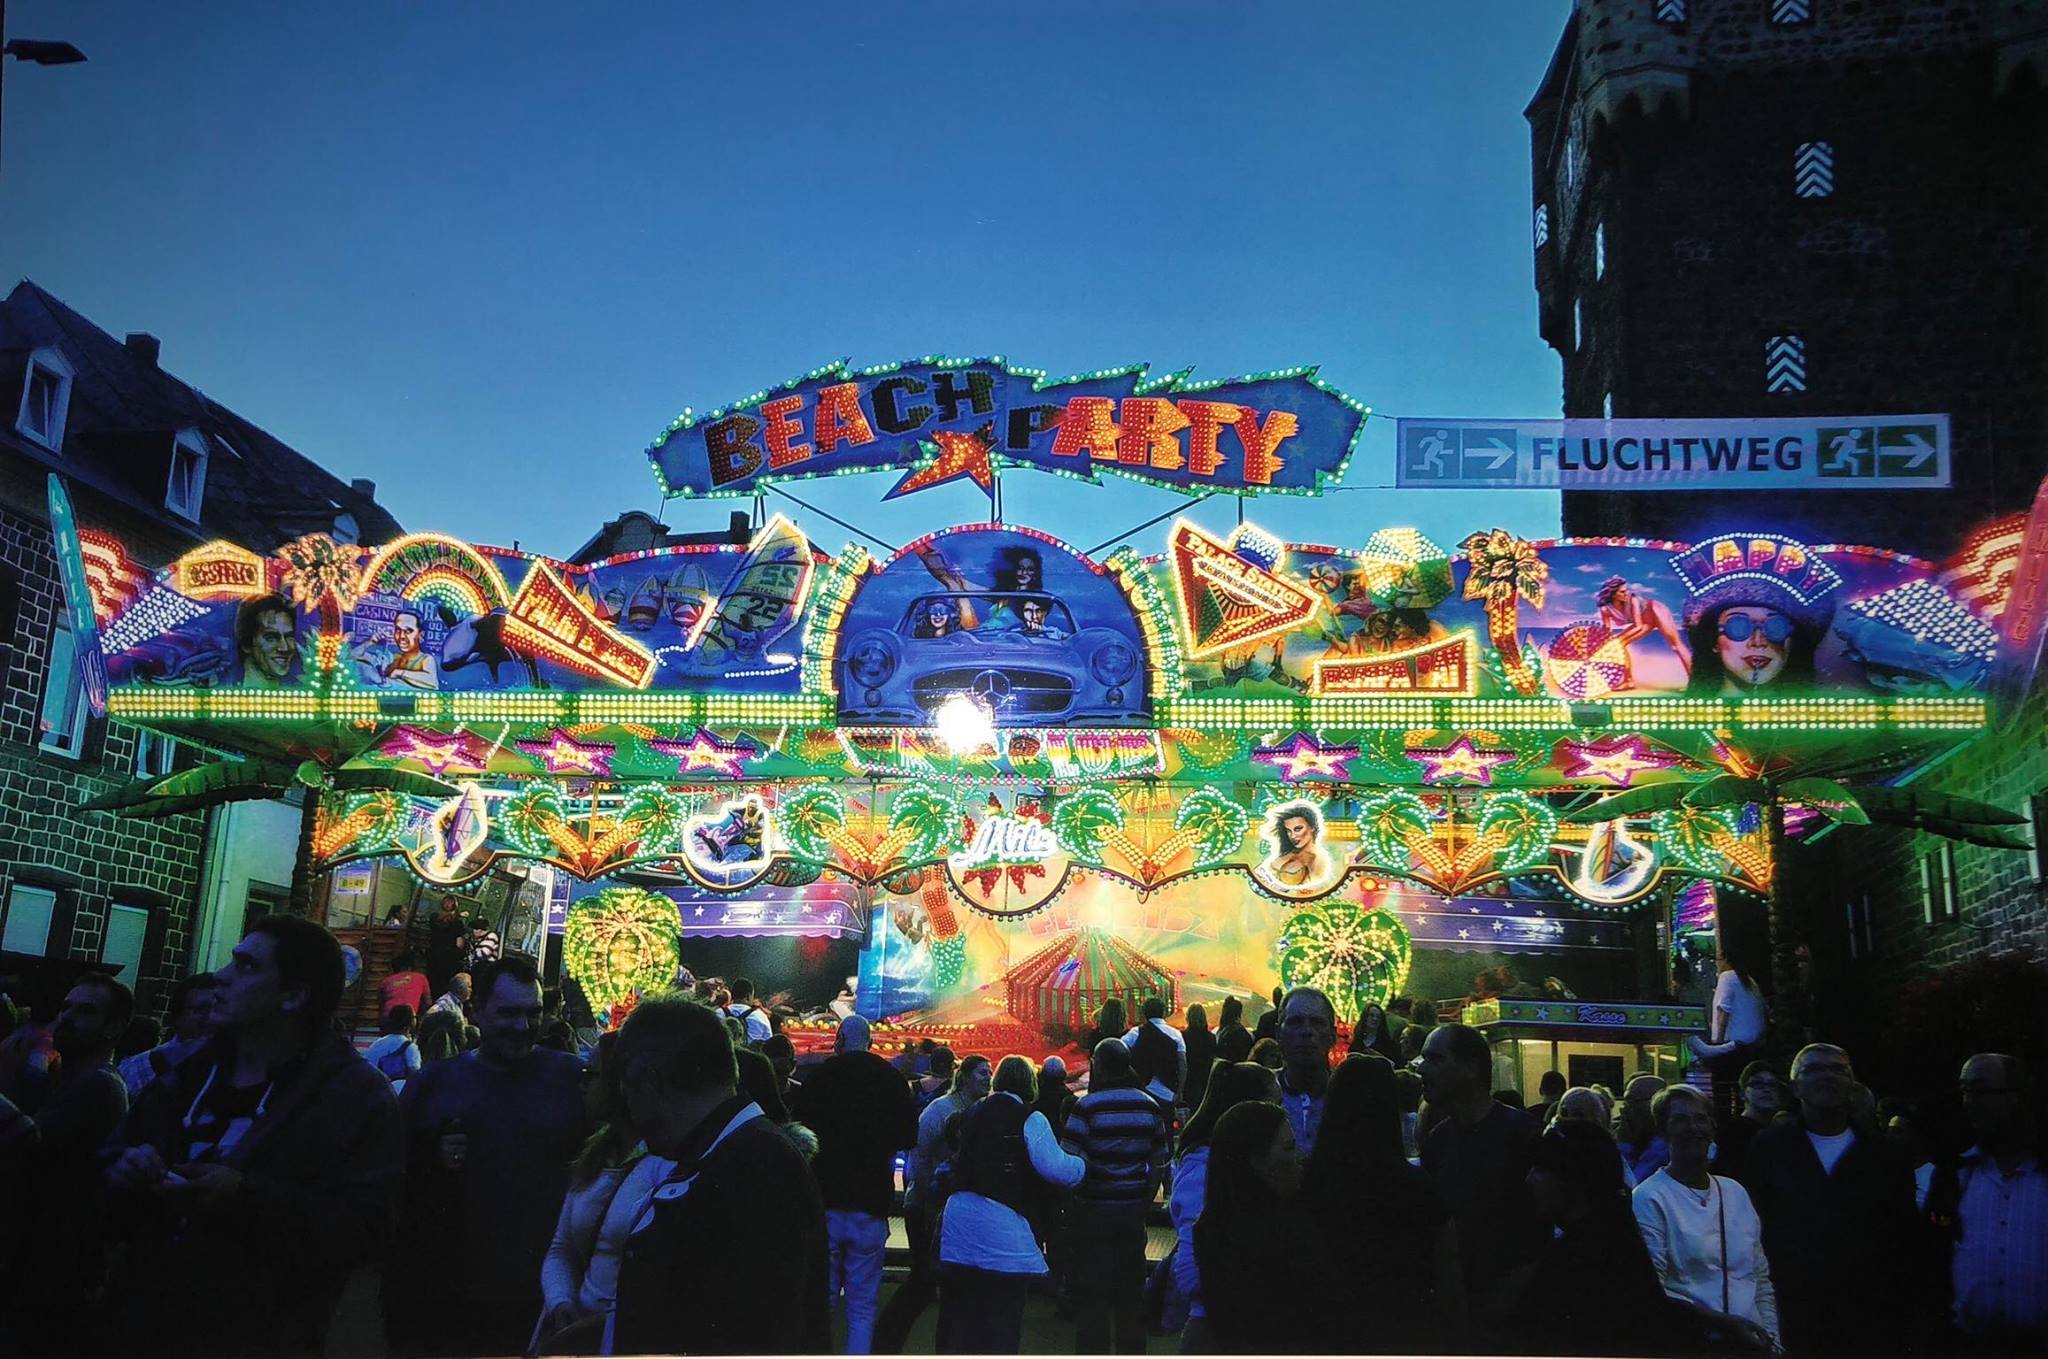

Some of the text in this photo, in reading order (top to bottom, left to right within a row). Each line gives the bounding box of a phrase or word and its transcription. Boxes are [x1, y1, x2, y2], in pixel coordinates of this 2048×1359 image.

[704, 371, 1297, 487] BEACH PARTY
[1532, 435, 1803, 472] FLUCHTWEG
[1245, 566, 1304, 610] STATION
[1577, 1004, 1627, 1025] Kasse
